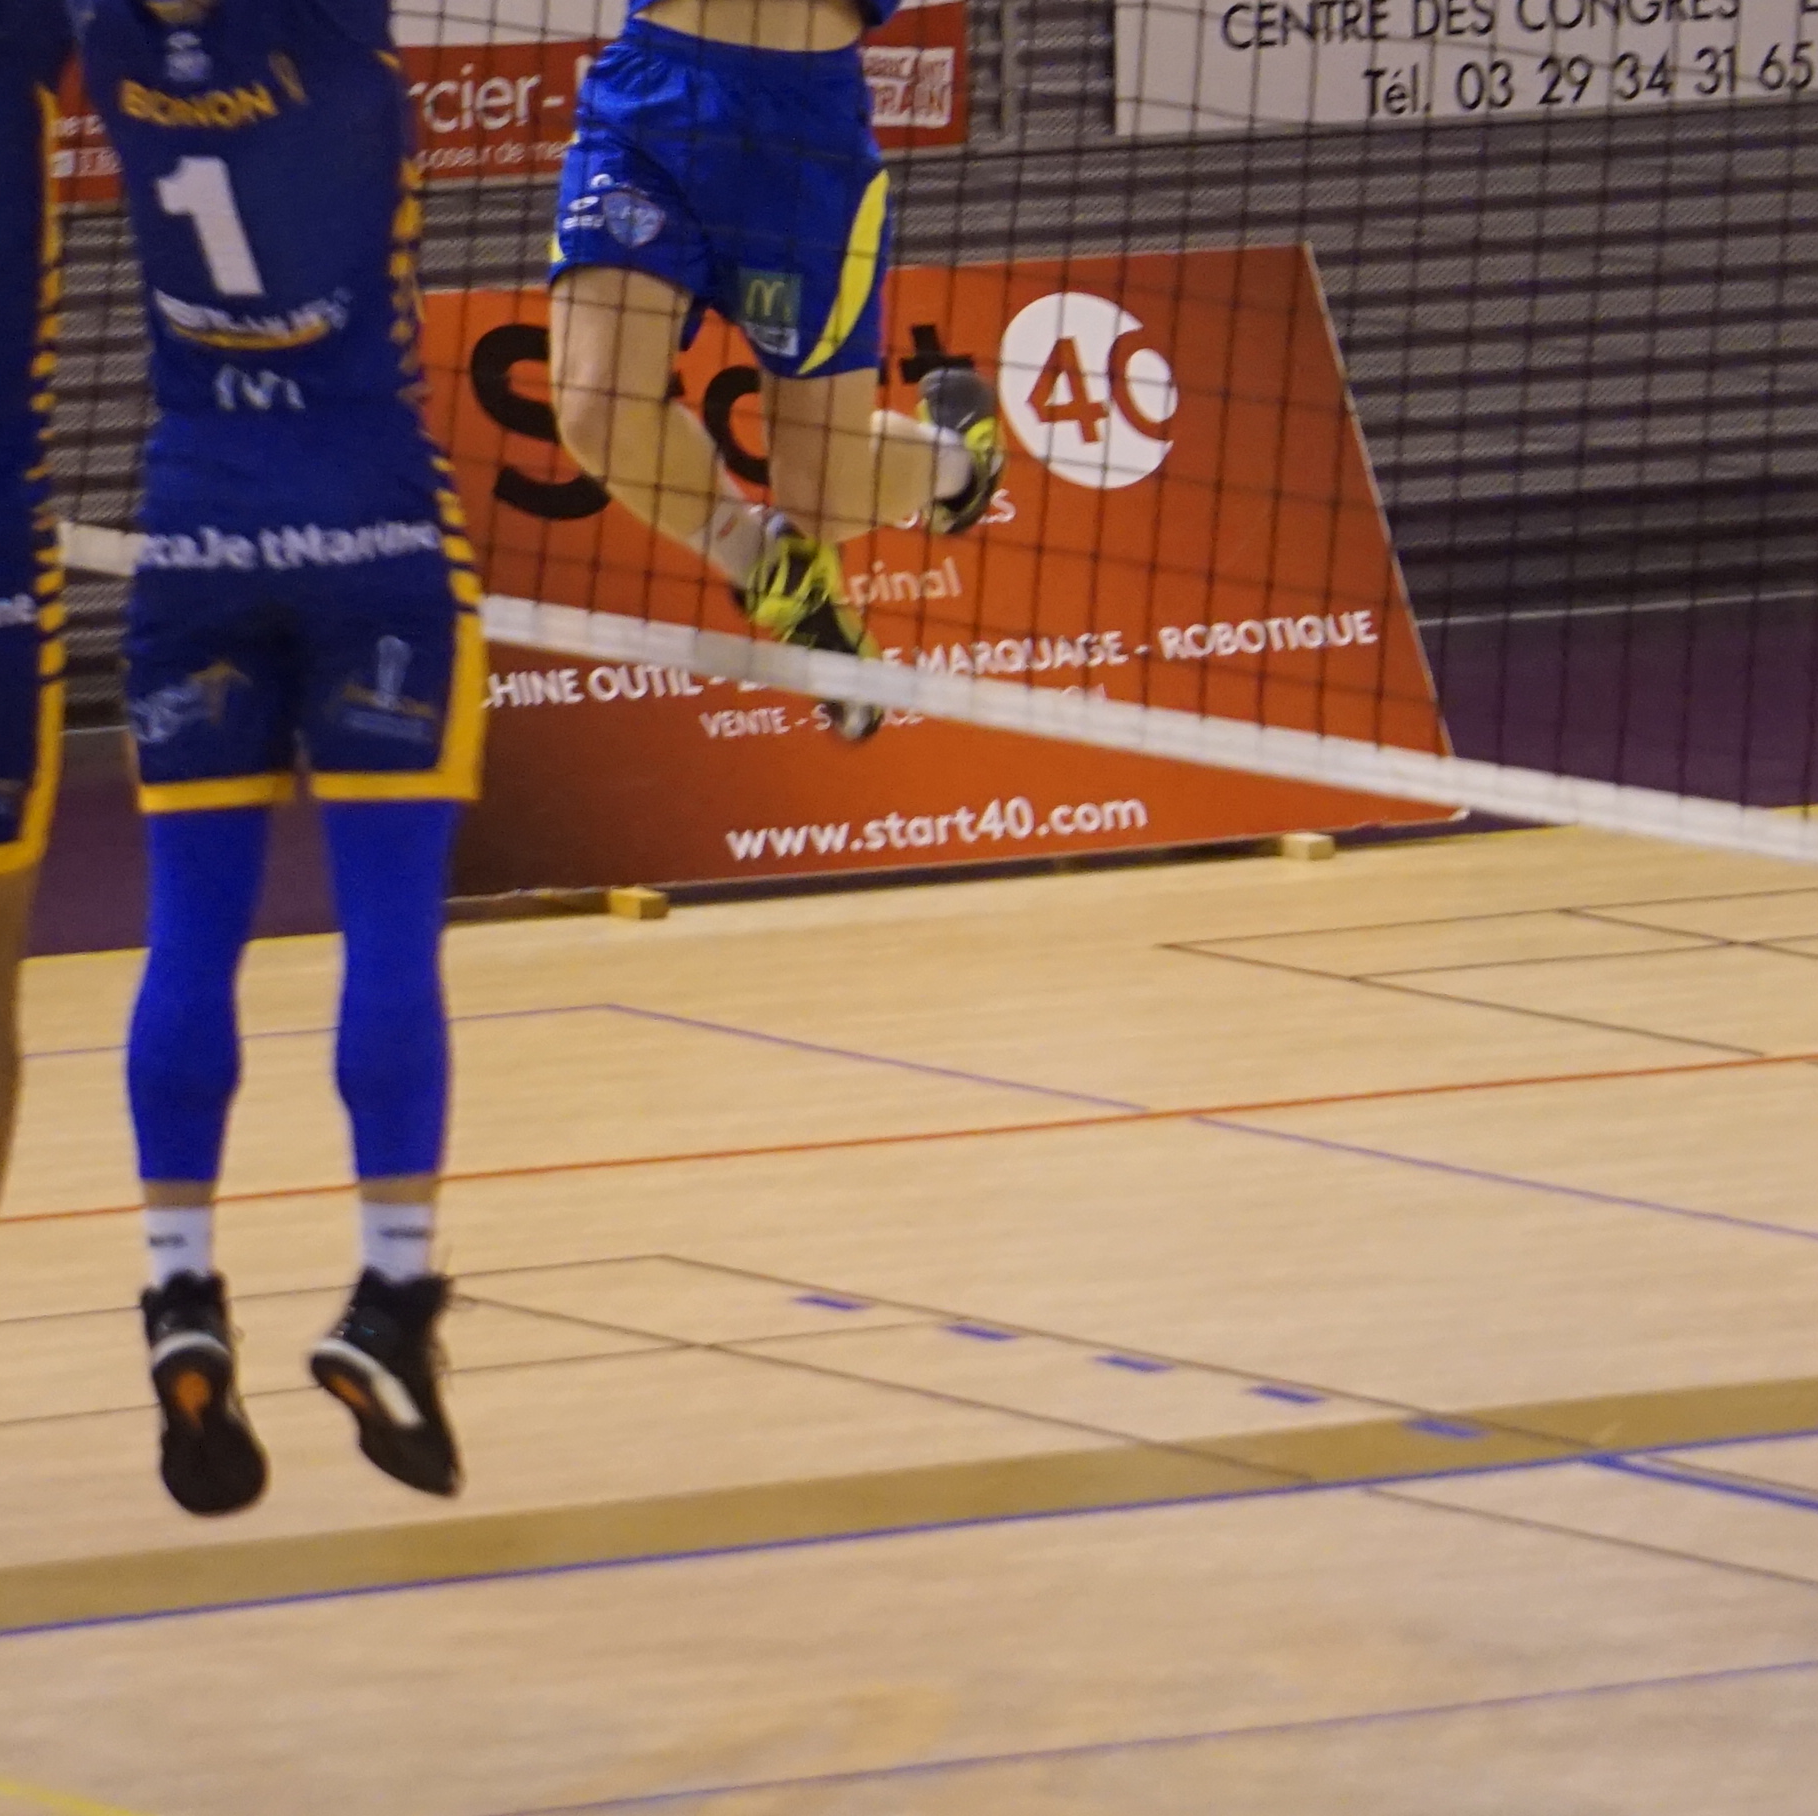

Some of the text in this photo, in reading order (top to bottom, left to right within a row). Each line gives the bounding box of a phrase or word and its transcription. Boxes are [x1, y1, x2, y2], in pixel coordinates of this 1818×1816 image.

[1363, 41, 1815, 121] Tél. 03 29 34 31 65
[154, 155, 265, 296] 1
[841, 558, 962, 605] pinal
[589, 665, 703, 703] OUTIL
[917, 630, 1129, 676] MARQUAGE
[1158, 610, 1377, 661] ROBOTIQUE
[700, 708, 785, 739] VENTE
[725, 796, 1147, 862] www.start40.com
